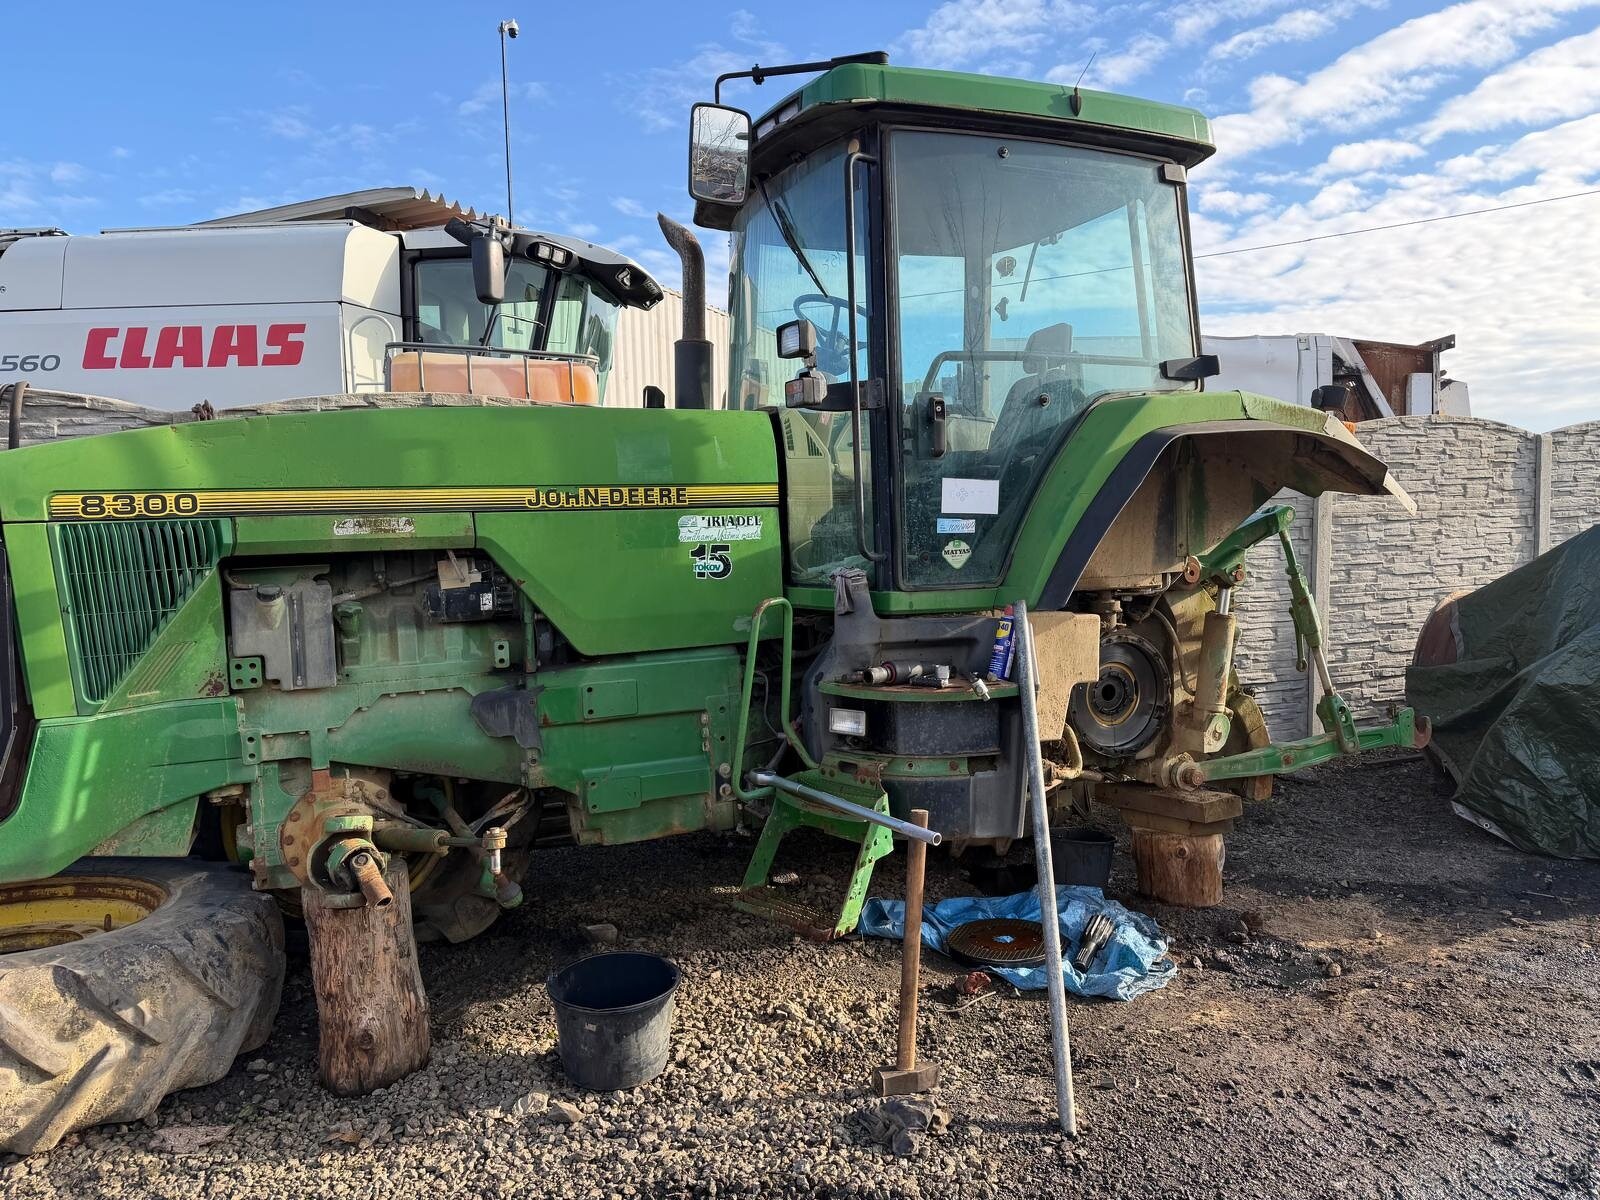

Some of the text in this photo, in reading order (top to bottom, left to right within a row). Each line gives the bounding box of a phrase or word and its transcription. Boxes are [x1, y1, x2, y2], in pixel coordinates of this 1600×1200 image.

[82, 323, 306, 369] CLAAS
[0, 354, 61, 372] 560
[80, 494, 200, 517] 8300
[526, 486, 688, 508] JOHN DEERE
[689, 544, 732, 579] 15
[694, 562, 721, 572] rokov
